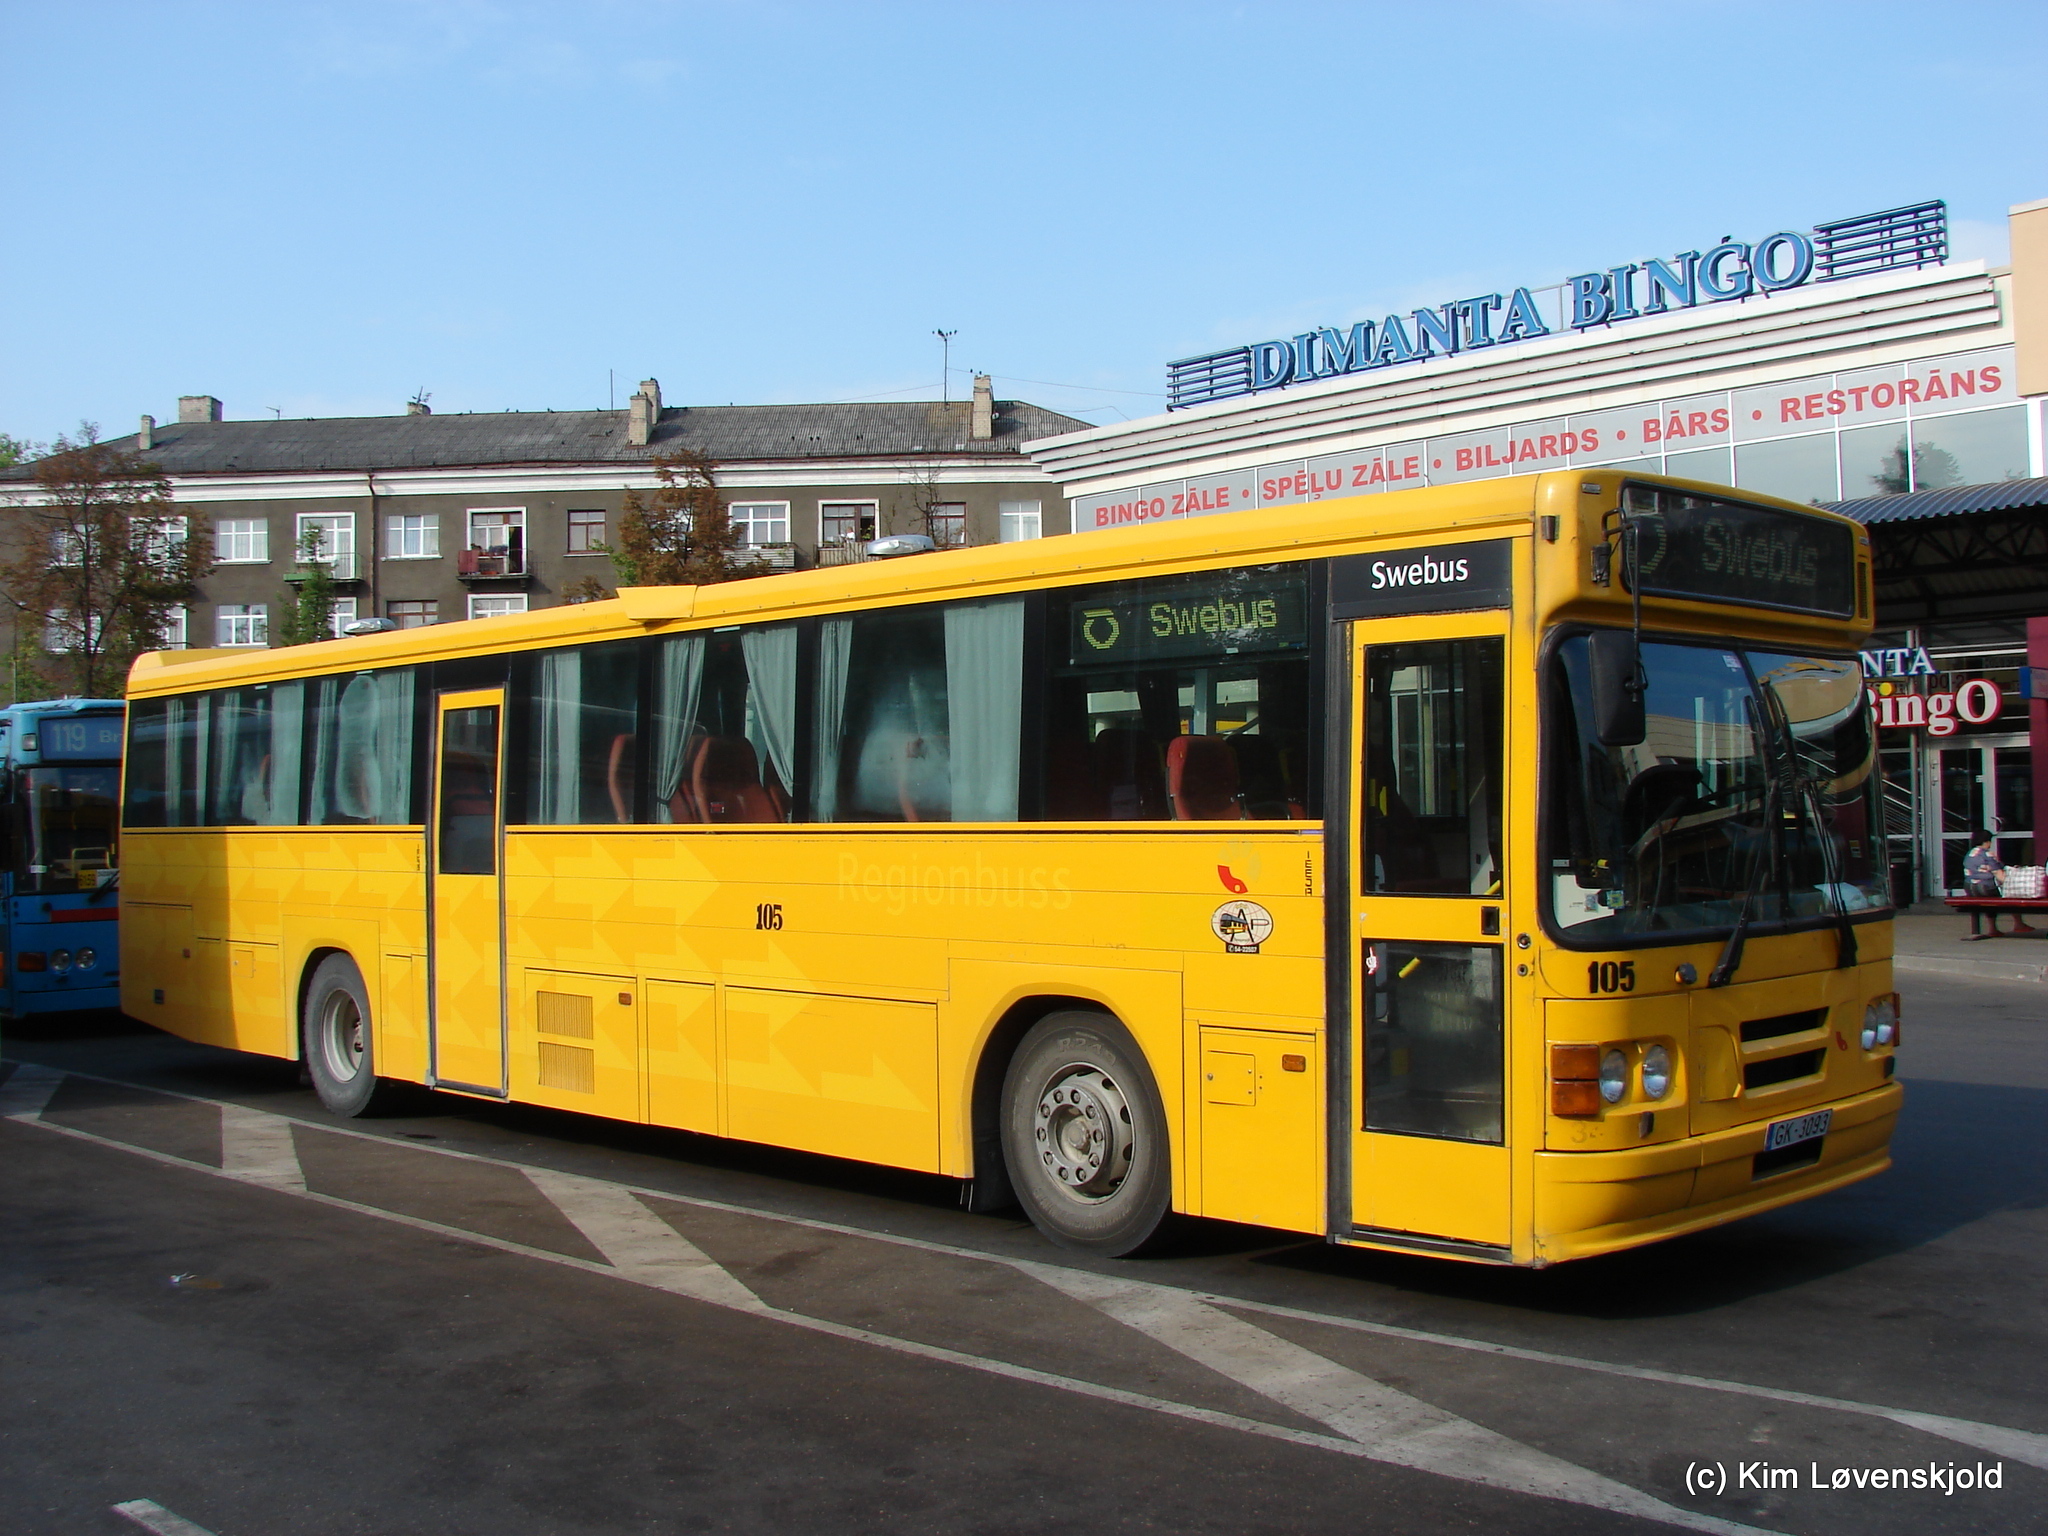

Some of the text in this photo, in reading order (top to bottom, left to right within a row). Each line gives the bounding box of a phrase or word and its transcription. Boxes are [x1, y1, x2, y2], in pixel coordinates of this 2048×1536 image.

[1250, 230, 1814, 392] DIMANTA BINGO
[1095, 366, 2002, 527] BINGO ZĀLE SPĒĻU ZĀLE BILJARDS BĀRS RESTORĀNS
[1703, 517, 1820, 586] Swebus
[1370, 555, 1470, 590] Swebus
[1150, 597, 1278, 638] Swebus
[53, 723, 86, 752] 119
[838, 852, 1073, 916] Regionbuss
[756, 903, 783, 931] 105
[1587, 960, 1635, 994] 105
